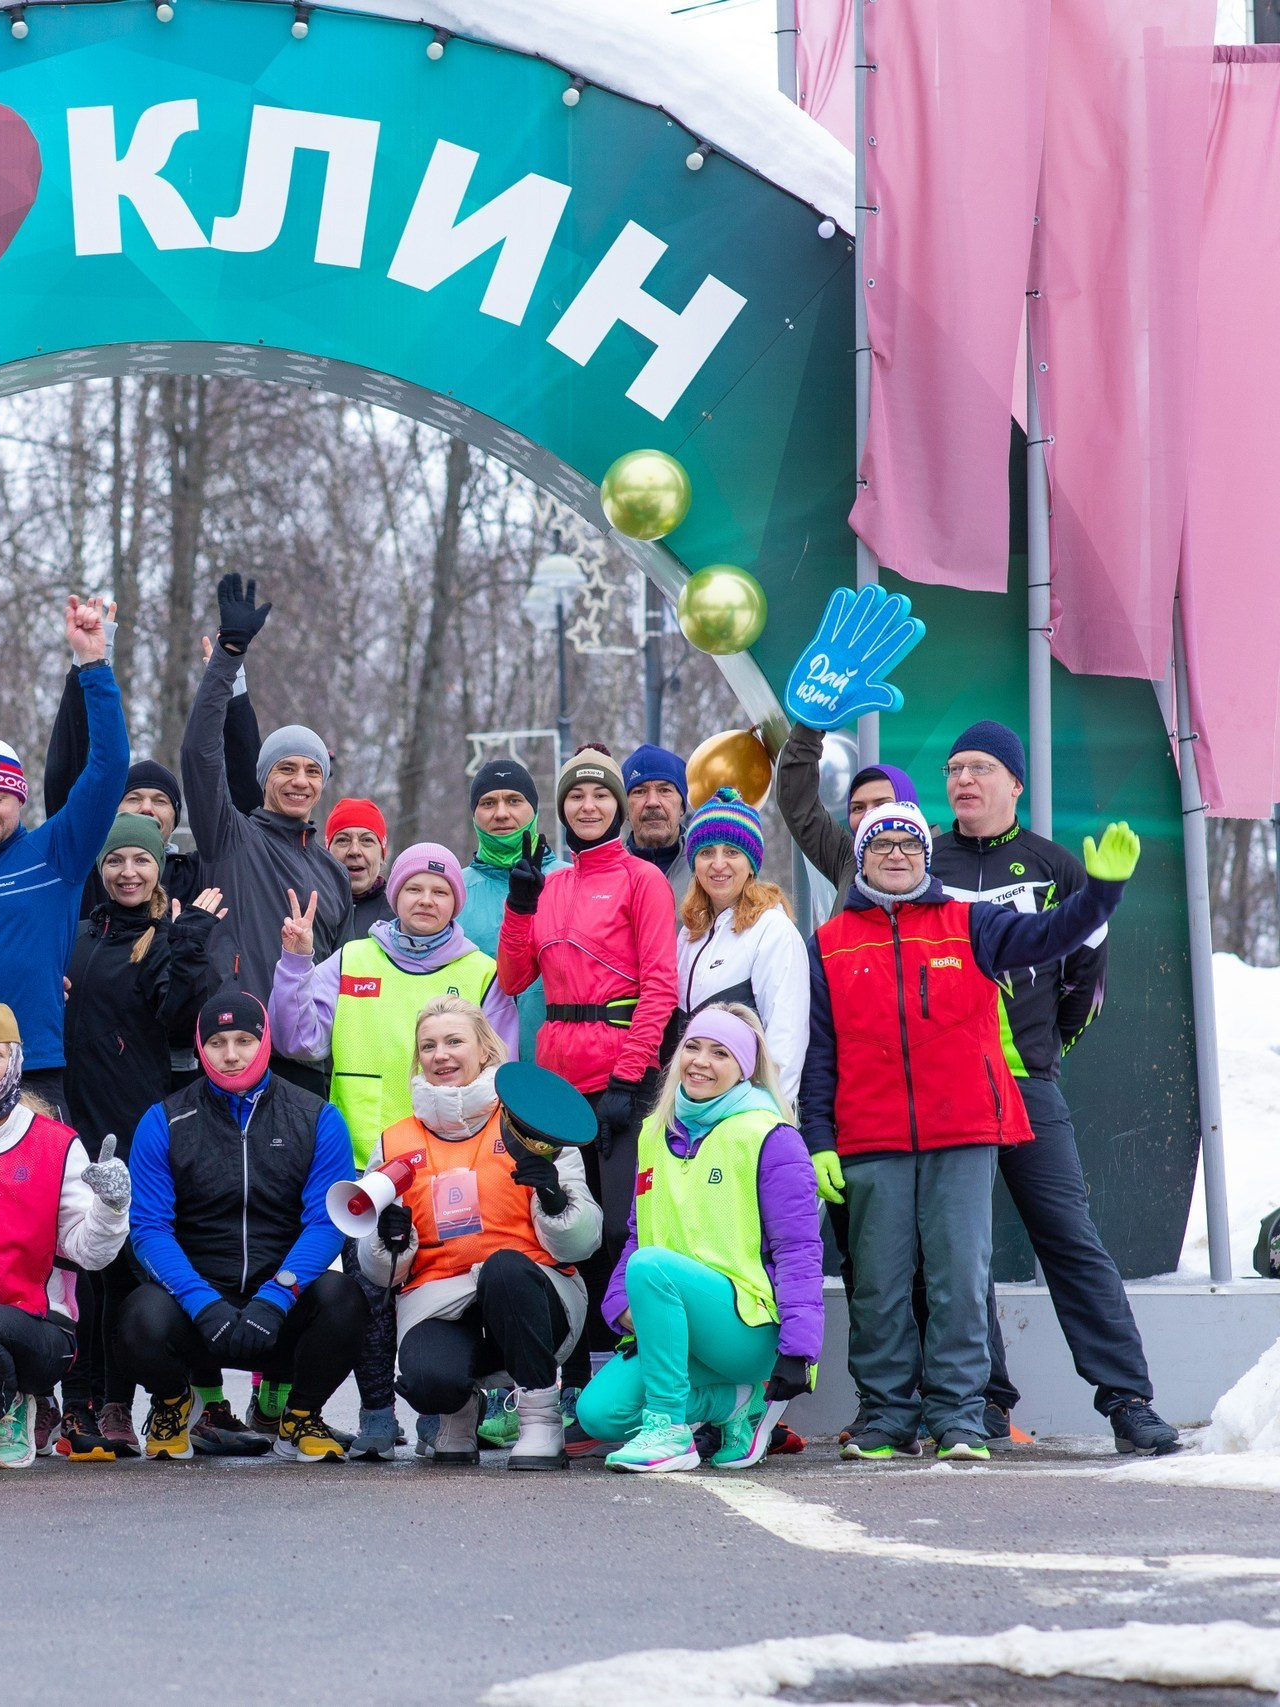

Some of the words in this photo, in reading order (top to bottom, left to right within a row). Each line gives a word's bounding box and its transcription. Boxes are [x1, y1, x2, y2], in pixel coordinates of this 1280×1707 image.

[66, 98, 748, 422] КЛИН
[806, 653, 859, 694] Дай
[795, 680, 840, 712] пять
